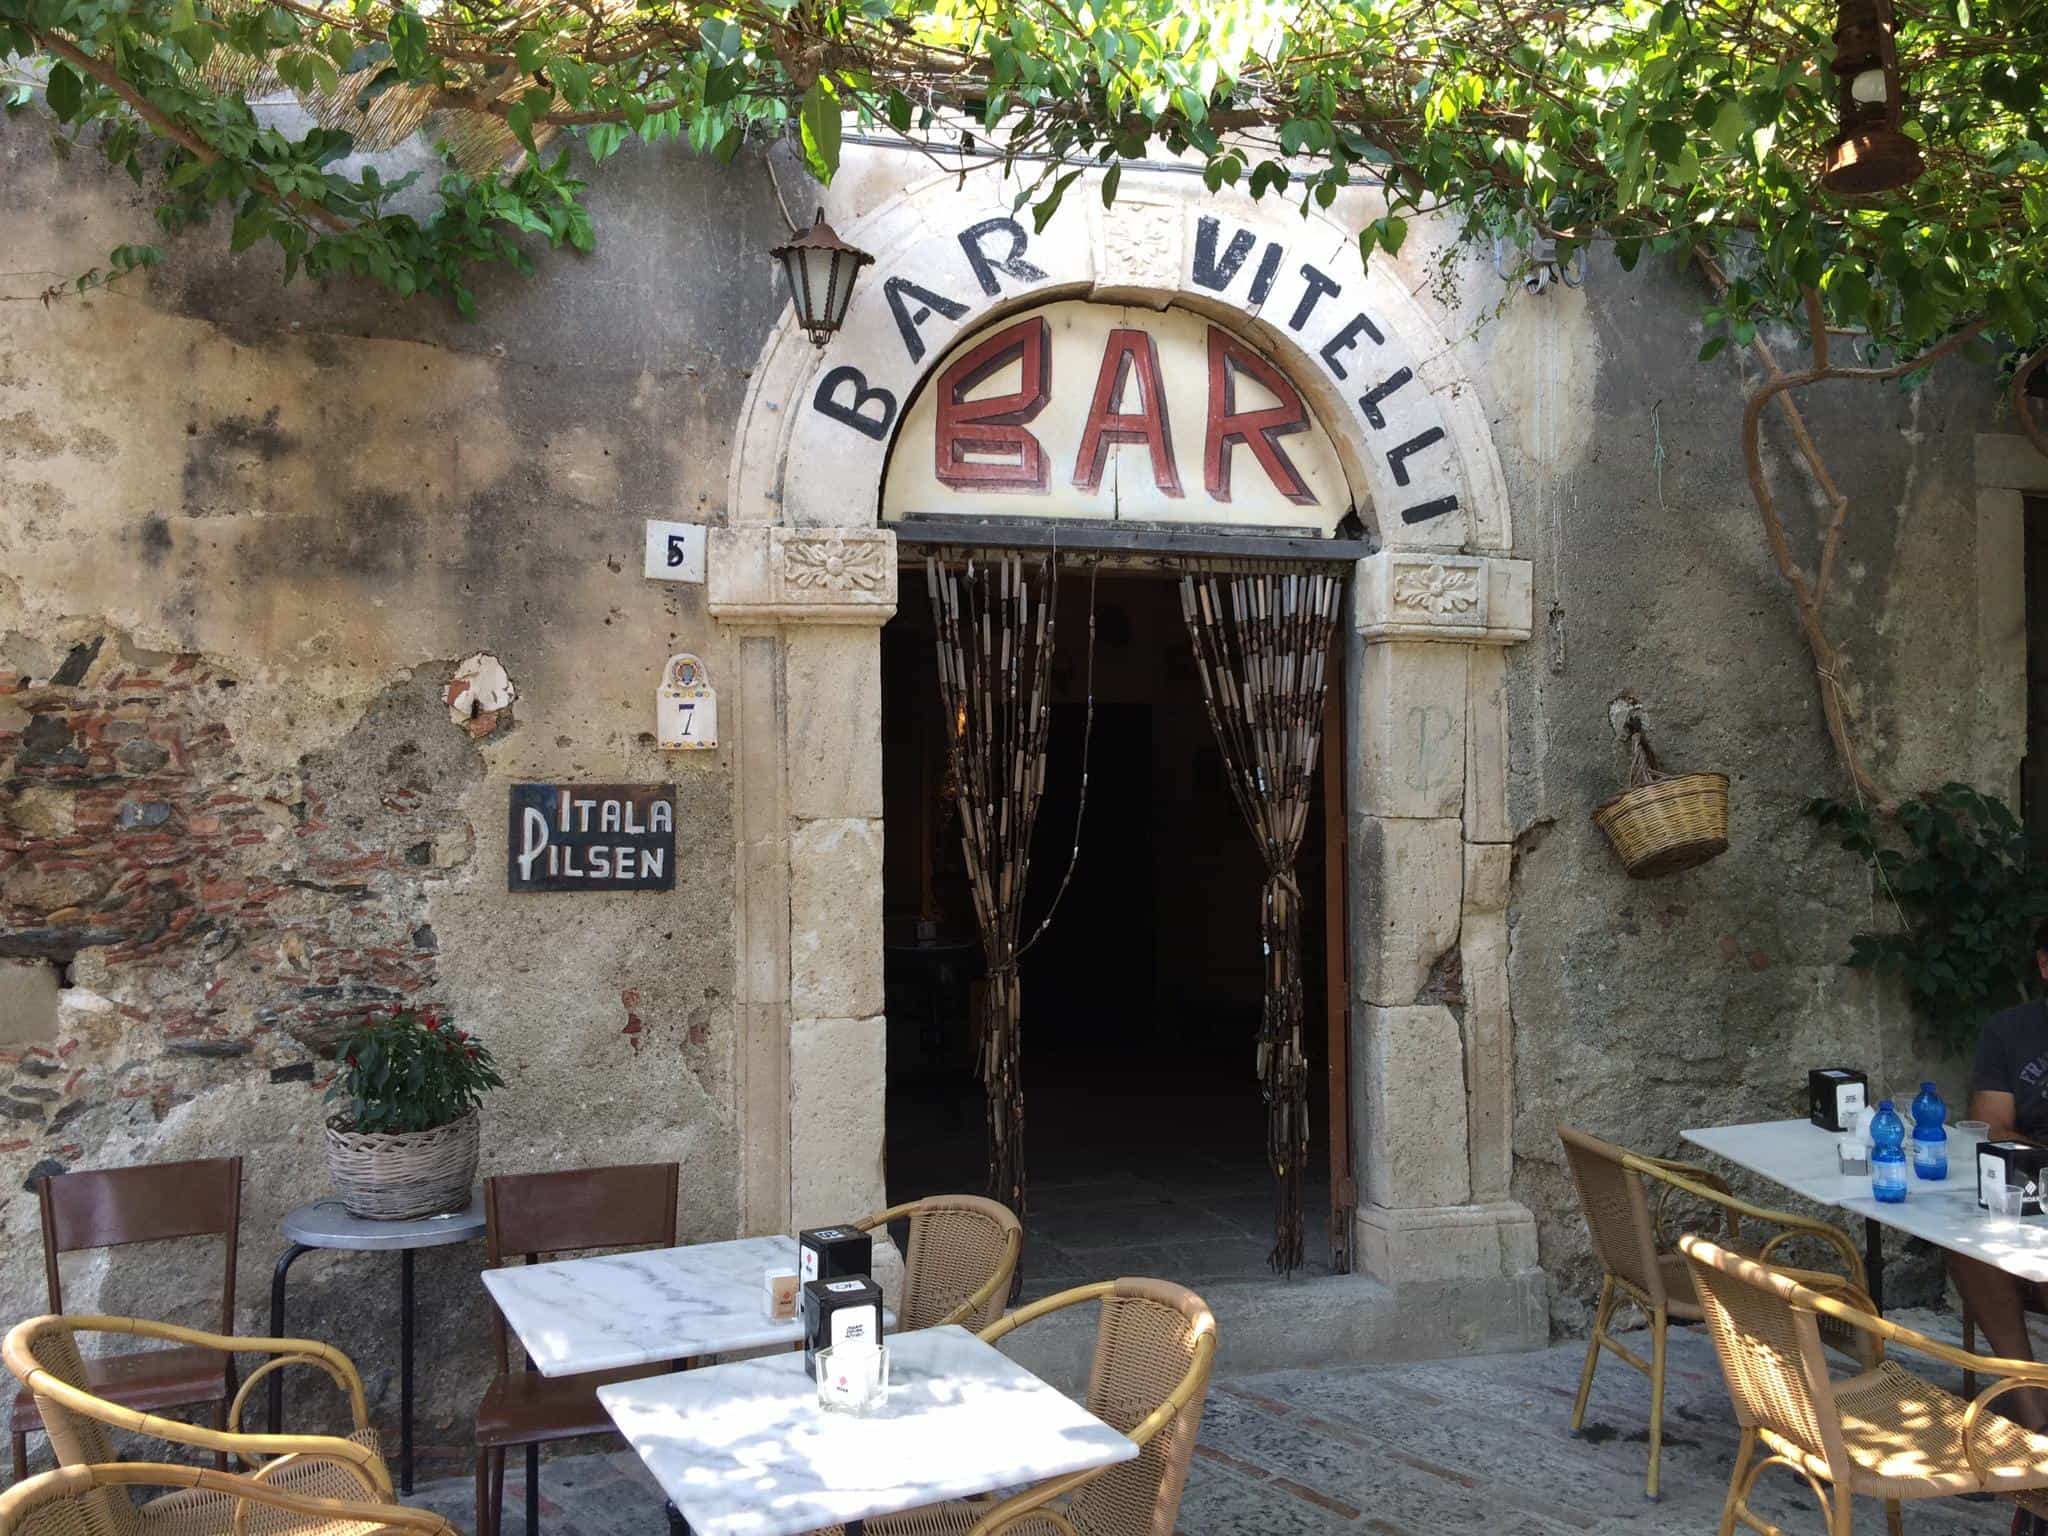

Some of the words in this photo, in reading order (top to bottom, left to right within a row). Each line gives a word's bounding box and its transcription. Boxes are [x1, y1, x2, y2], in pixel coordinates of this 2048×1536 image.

[813, 217, 1050, 441] BAR
[1192, 215, 1459, 525] VITELLI
[936, 315, 1320, 506] BAR
[667, 534, 685, 568] 5
[678, 703, 696, 736] 7
[556, 789, 673, 835] ITALA
[517, 806, 664, 881] PILSEN
[2019, 1051, 2048, 1086] FRA
